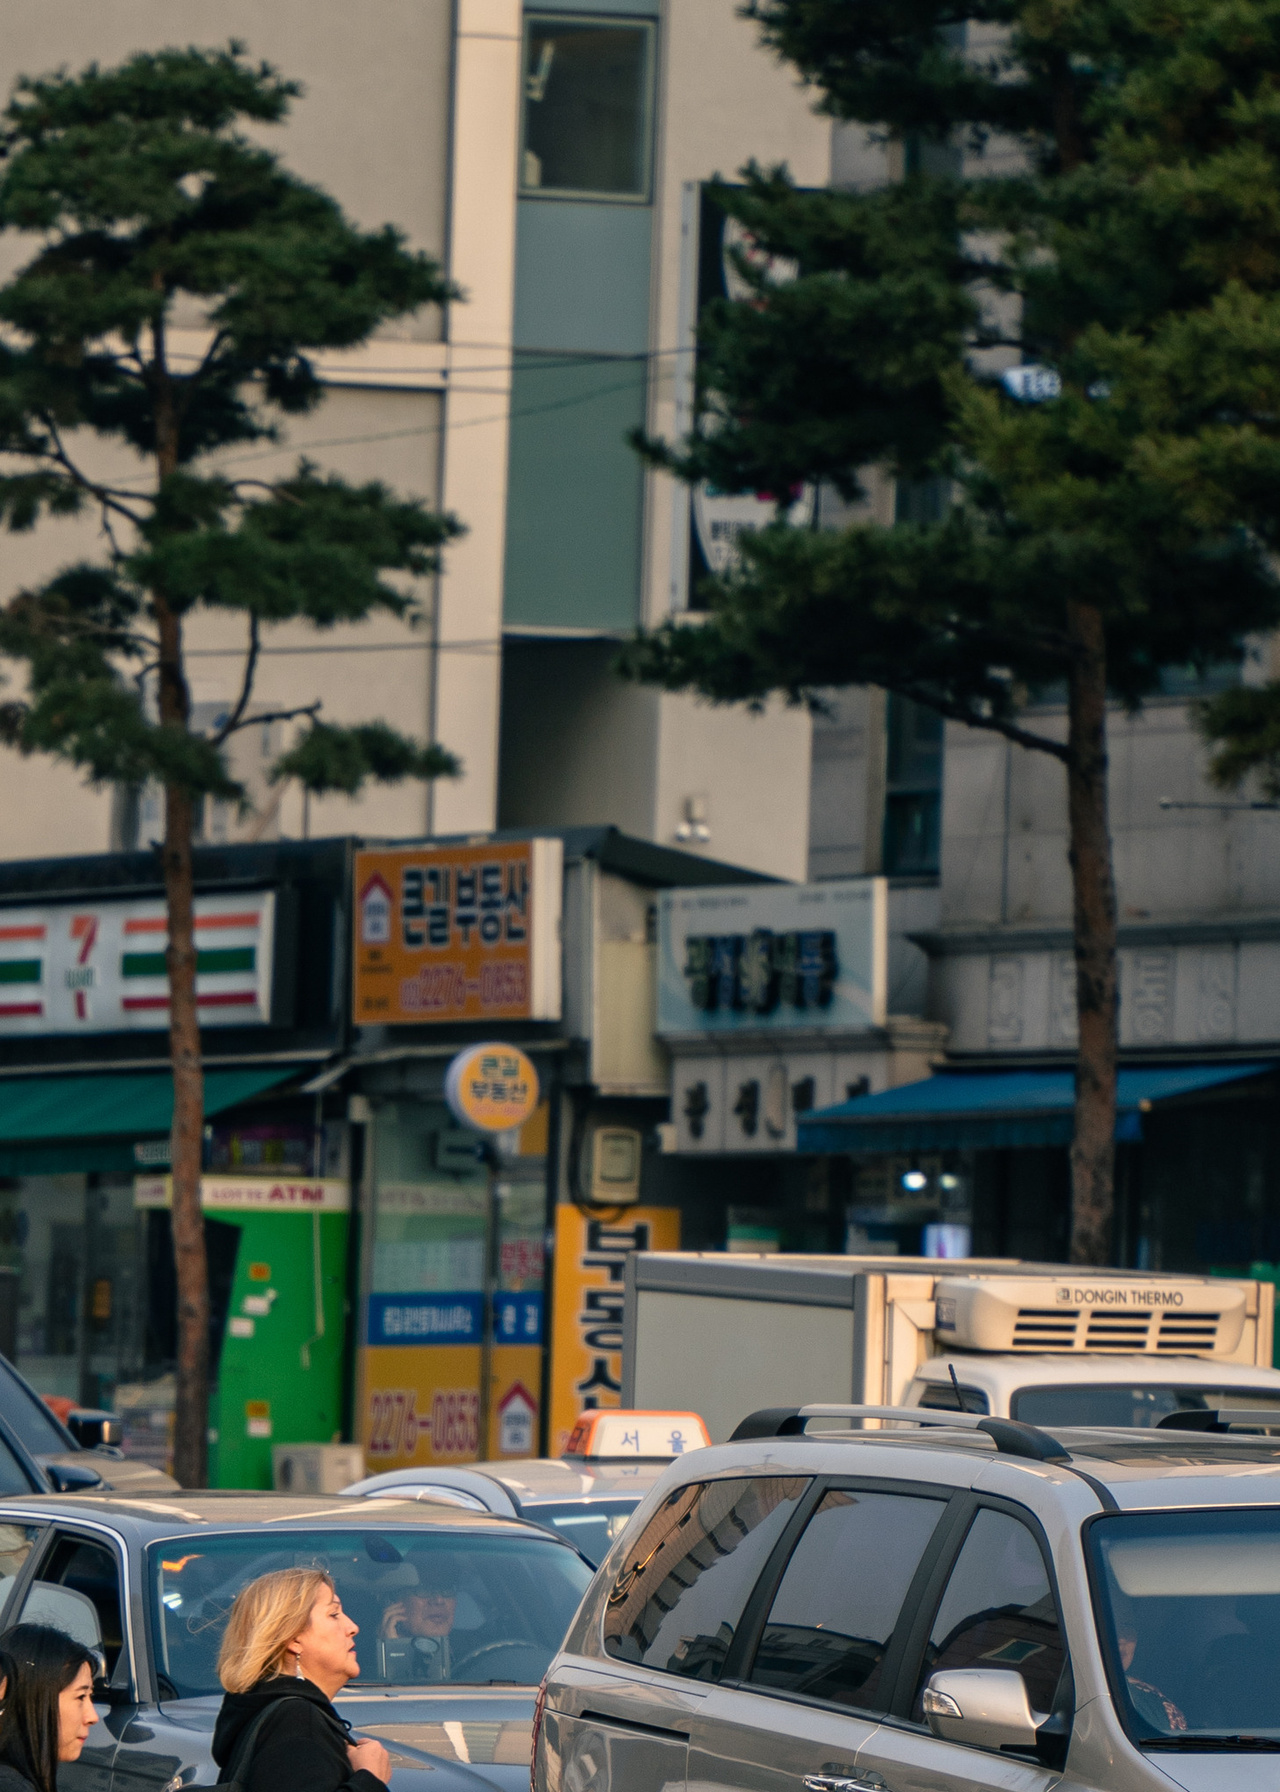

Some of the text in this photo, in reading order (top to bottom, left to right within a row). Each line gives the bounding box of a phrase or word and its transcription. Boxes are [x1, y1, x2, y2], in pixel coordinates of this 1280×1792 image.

[268, 1183, 325, 1203] ATM
[1074, 1289, 1183, 1307] DONGIN THERMO
